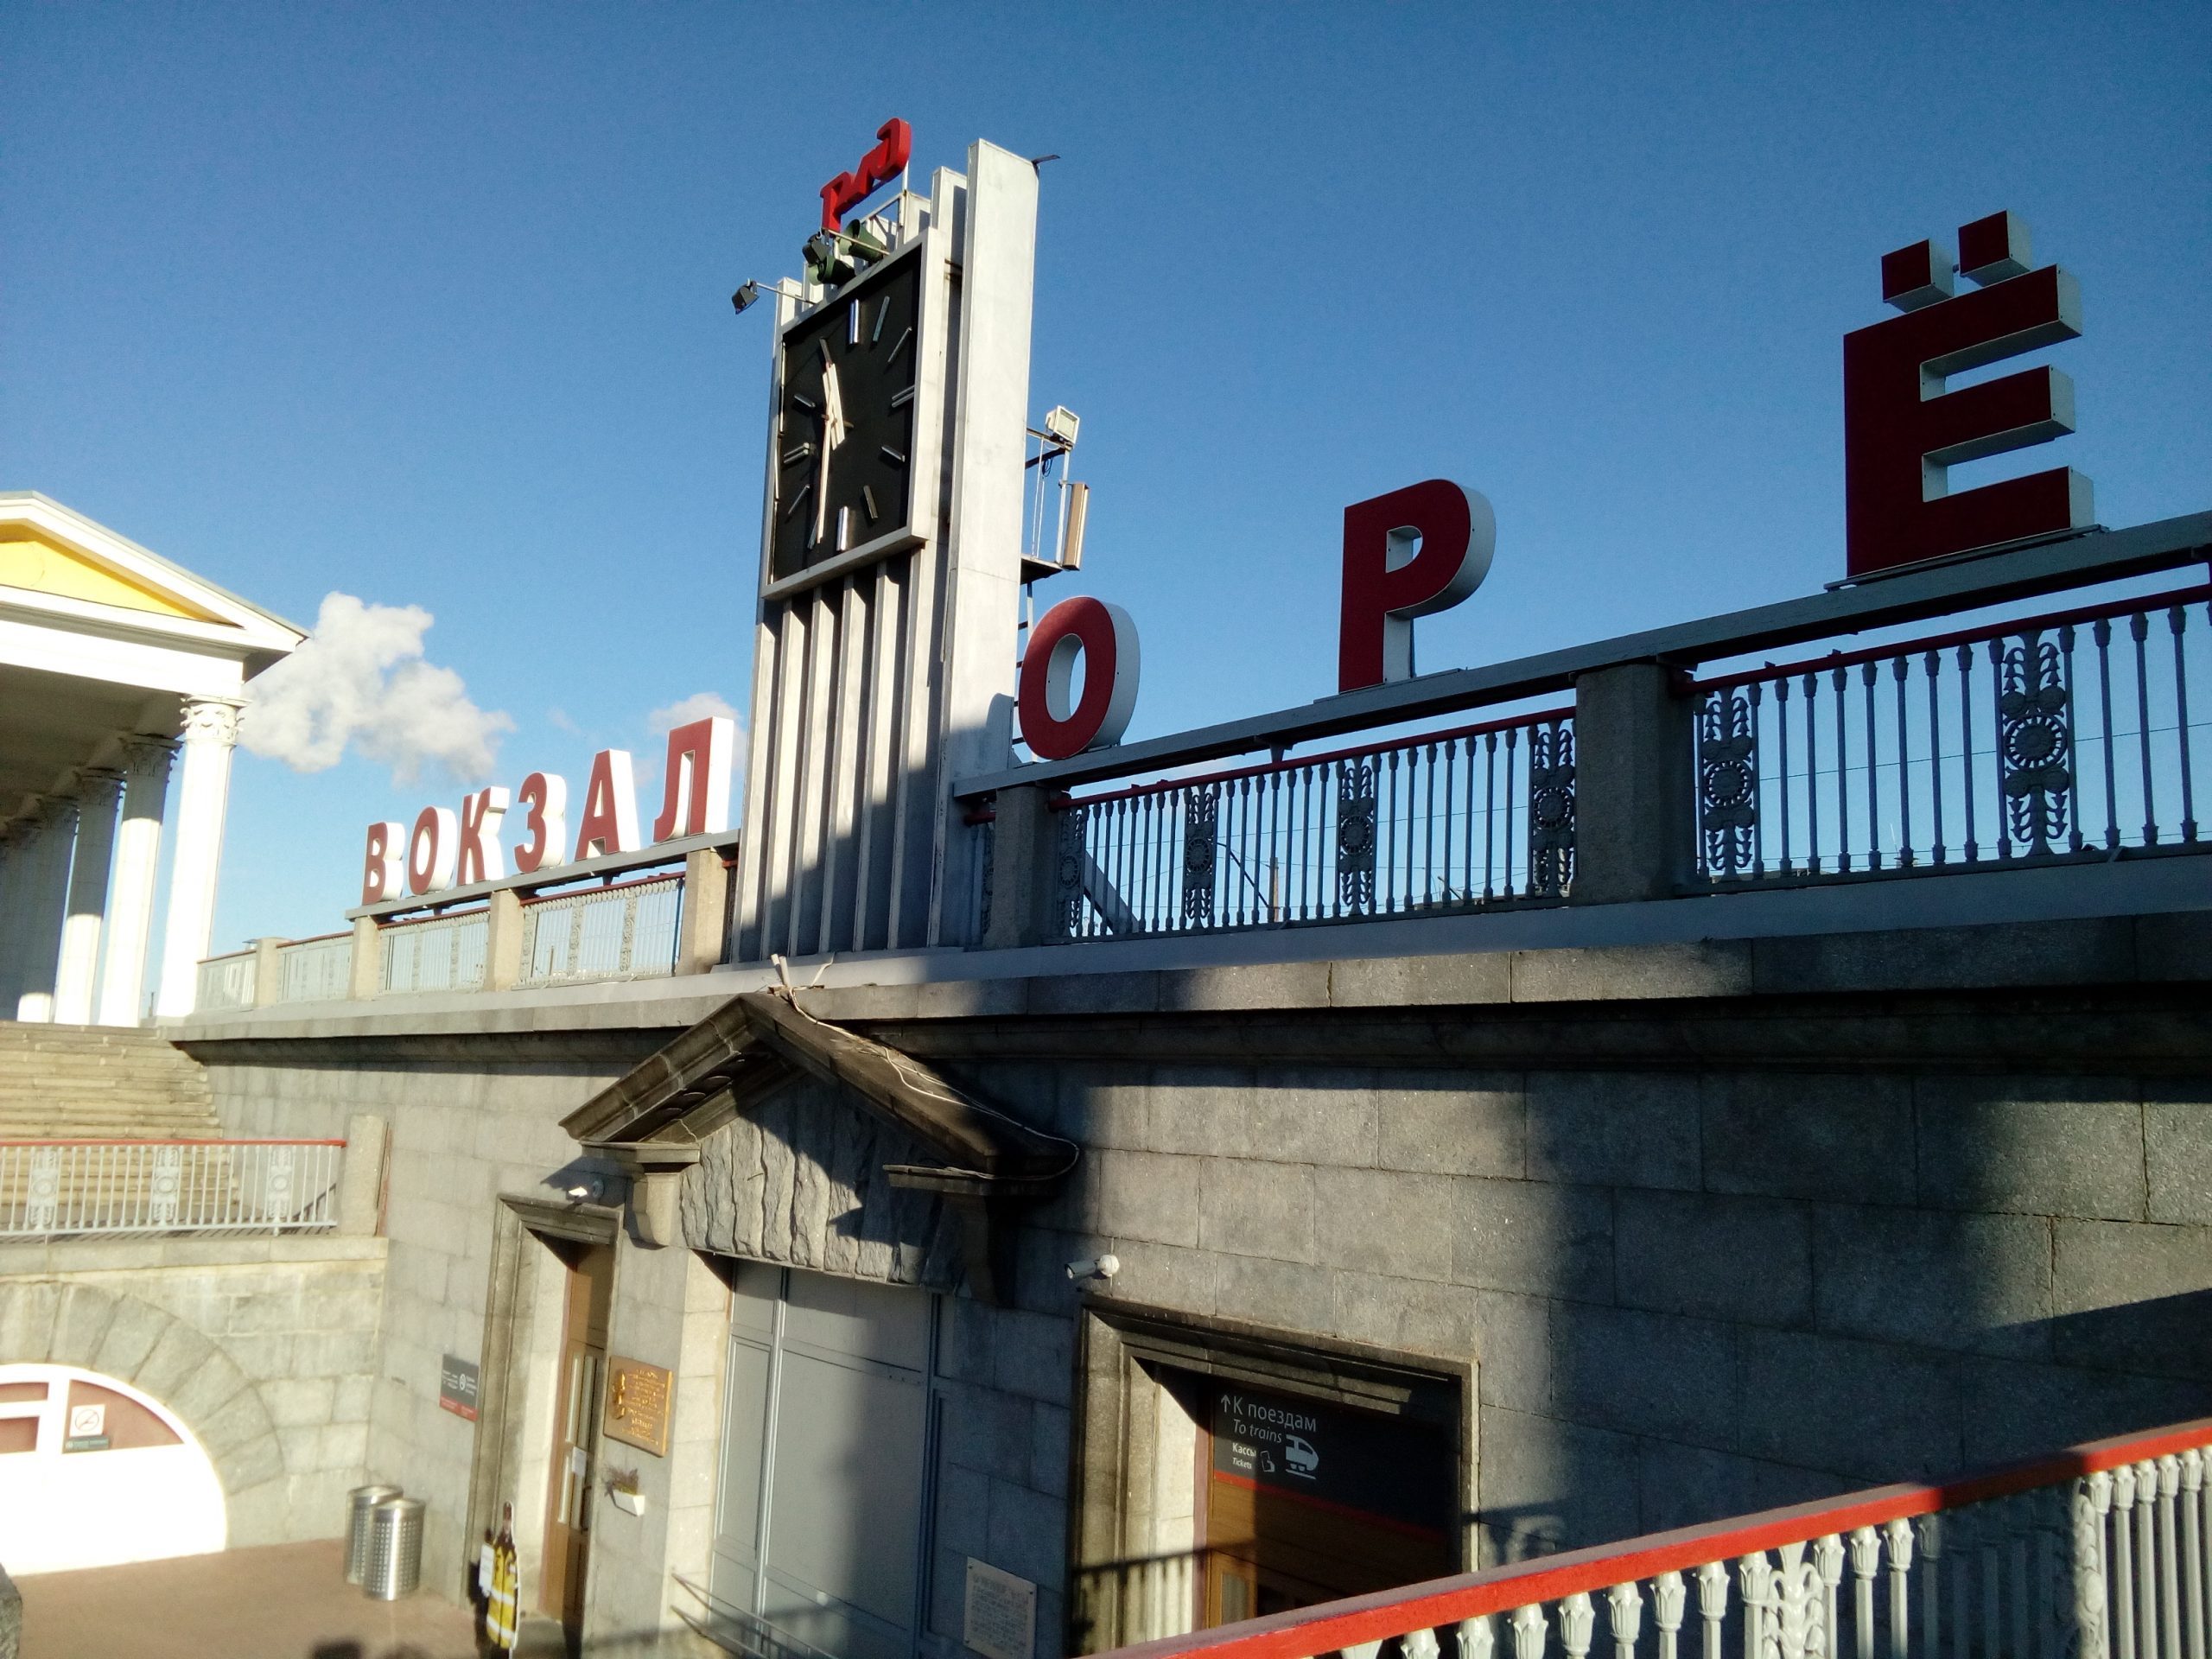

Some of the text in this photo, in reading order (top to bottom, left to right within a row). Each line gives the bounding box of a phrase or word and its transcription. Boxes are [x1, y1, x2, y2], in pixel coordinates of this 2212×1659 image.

[361, 716, 734, 906] ВОКЗАЛ
[1234, 1396, 1317, 1432] К поездам
[1234, 1419, 1282, 1443] To trains
[1232, 1443, 1256, 1457] Кассы
[1233, 1458, 1252, 1469] Tickets
